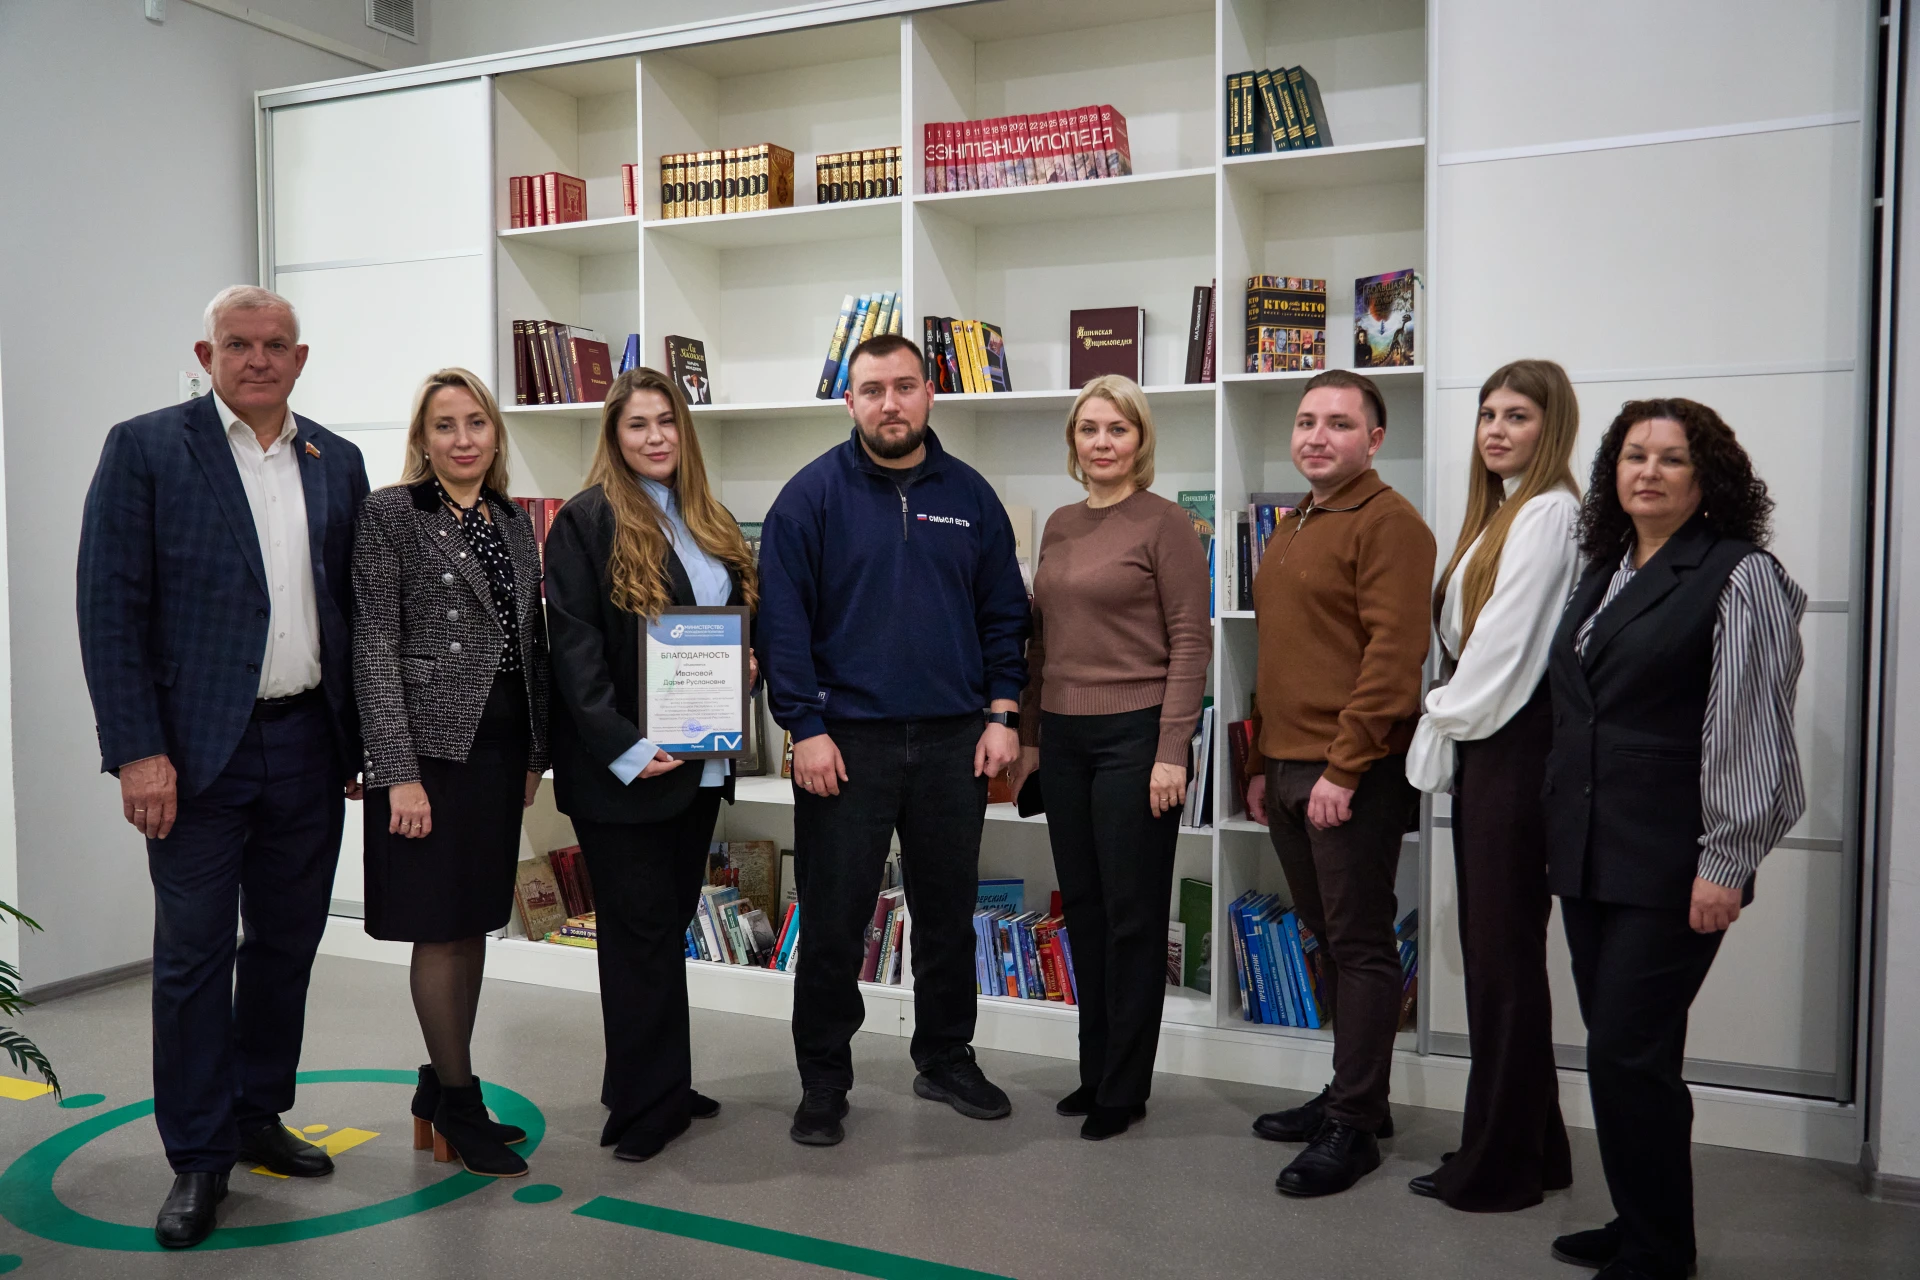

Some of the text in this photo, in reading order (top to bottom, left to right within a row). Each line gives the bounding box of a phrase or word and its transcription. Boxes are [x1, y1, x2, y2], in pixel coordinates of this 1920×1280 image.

[1069, 116, 1077, 126] 27
[1080, 114, 1088, 123] 28
[1089, 113, 1098, 122] 29
[1101, 112, 1111, 121] 32
[1019, 122, 1027, 130] 21
[1029, 122, 1038, 131] 22
[1040, 121, 1048, 129] 24
[1049, 119, 1057, 128] 25
[1059, 118, 1067, 126] 26
[974, 128, 981, 136] 11
[983, 127, 990, 135] 12
[991, 126, 999, 134] 18
[1000, 124, 1008, 133] 19
[1009, 123, 1018, 132] 20
[928, 131, 931, 139] 1
[937, 130, 941, 138] 1
[946, 130, 952, 138] 2
[956, 130, 961, 138] 3
[1248, 296, 1259, 305] КТО
[1264, 299, 1289, 311] КТО
[1248, 307, 1259, 316] КТО
[1301, 301, 1325, 313] КТО
[1083, 337, 1133, 350] Энциклопедия
[1182, 494, 1208, 502] Геннадий
[929, 515, 970, 527] СМЫСЛ ЕСТЬ
[661, 651, 730, 660] БЛАГОДАРНОСТЬ
[686, 678, 726, 686] Руслановне
[1252, 953, 1266, 1003] ПРЕОДОЛЕНИЕ
